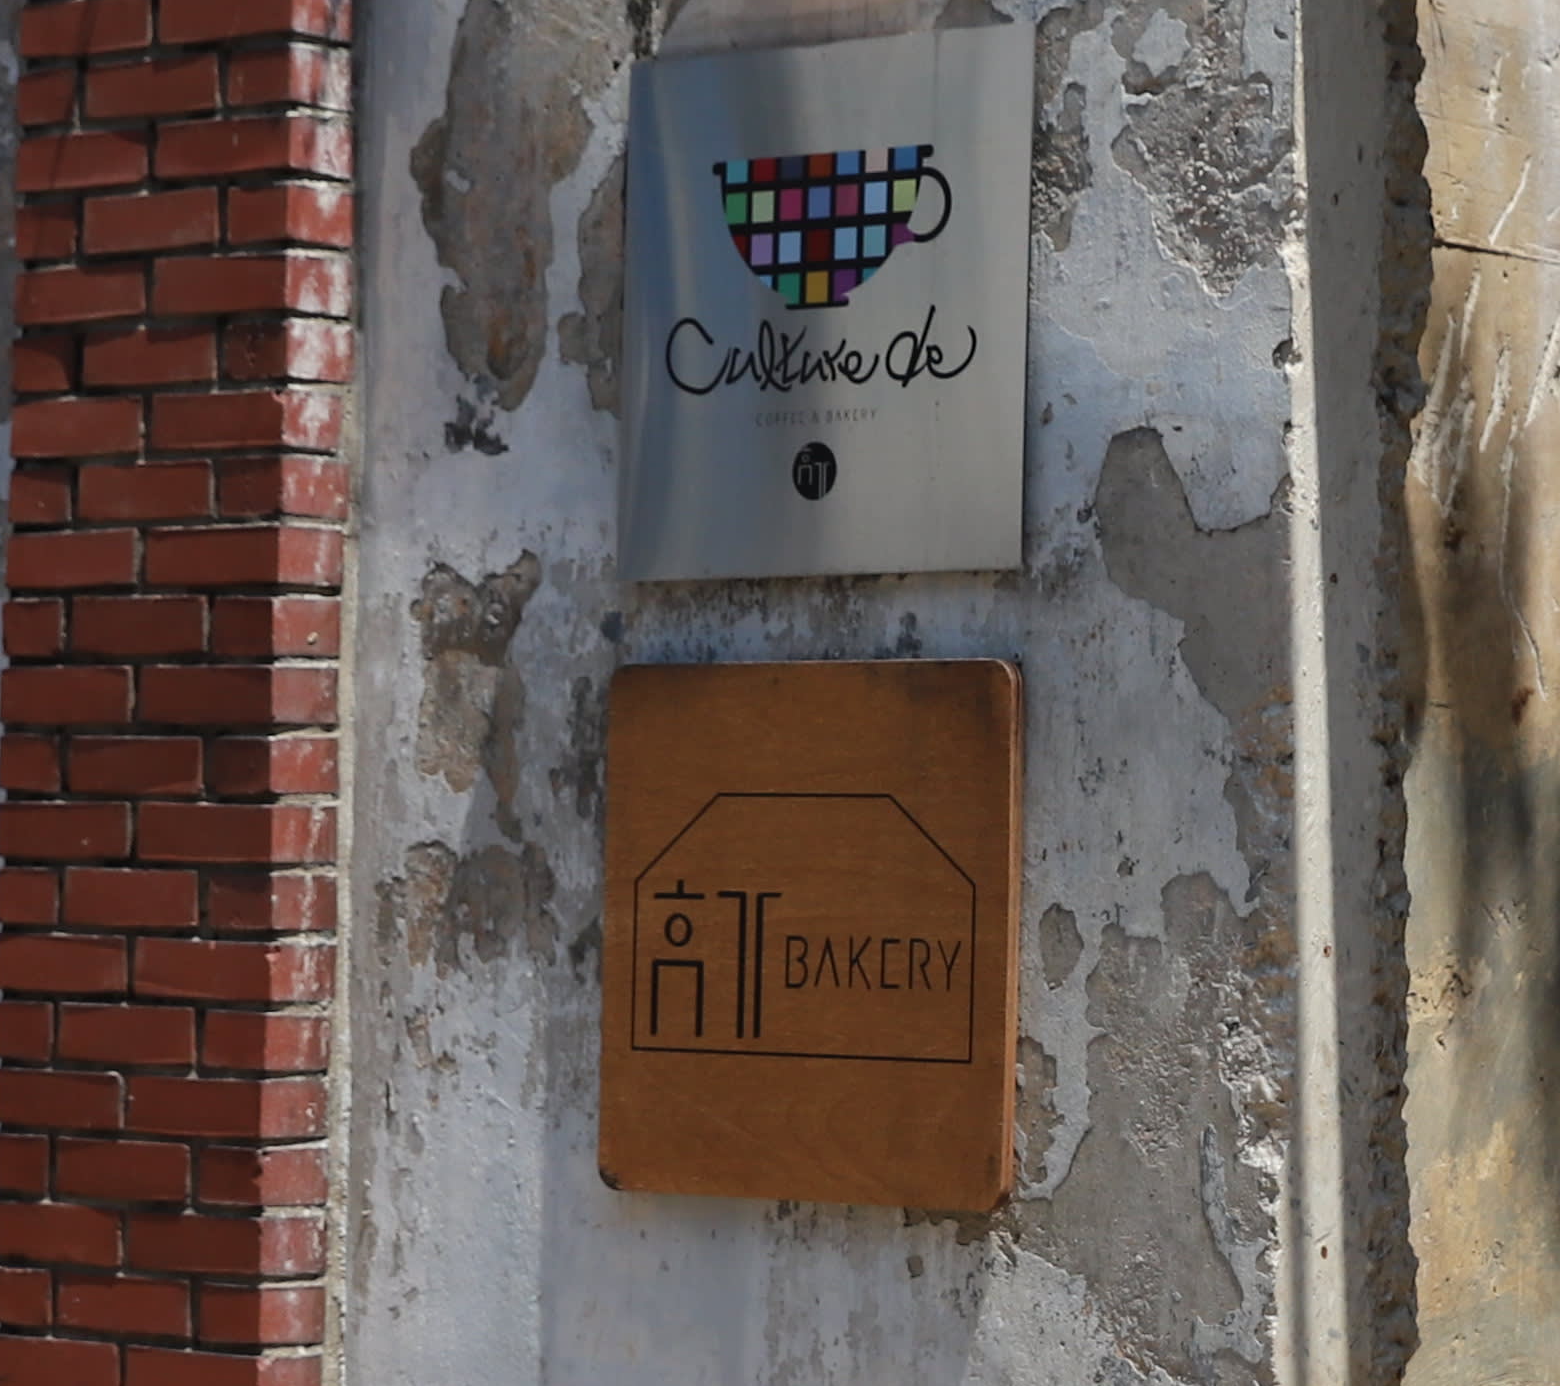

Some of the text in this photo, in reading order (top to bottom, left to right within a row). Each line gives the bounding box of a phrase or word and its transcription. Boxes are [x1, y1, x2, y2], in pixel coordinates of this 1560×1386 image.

[665, 305, 977, 395] Culture de
[784, 935, 962, 992] BAKERY
